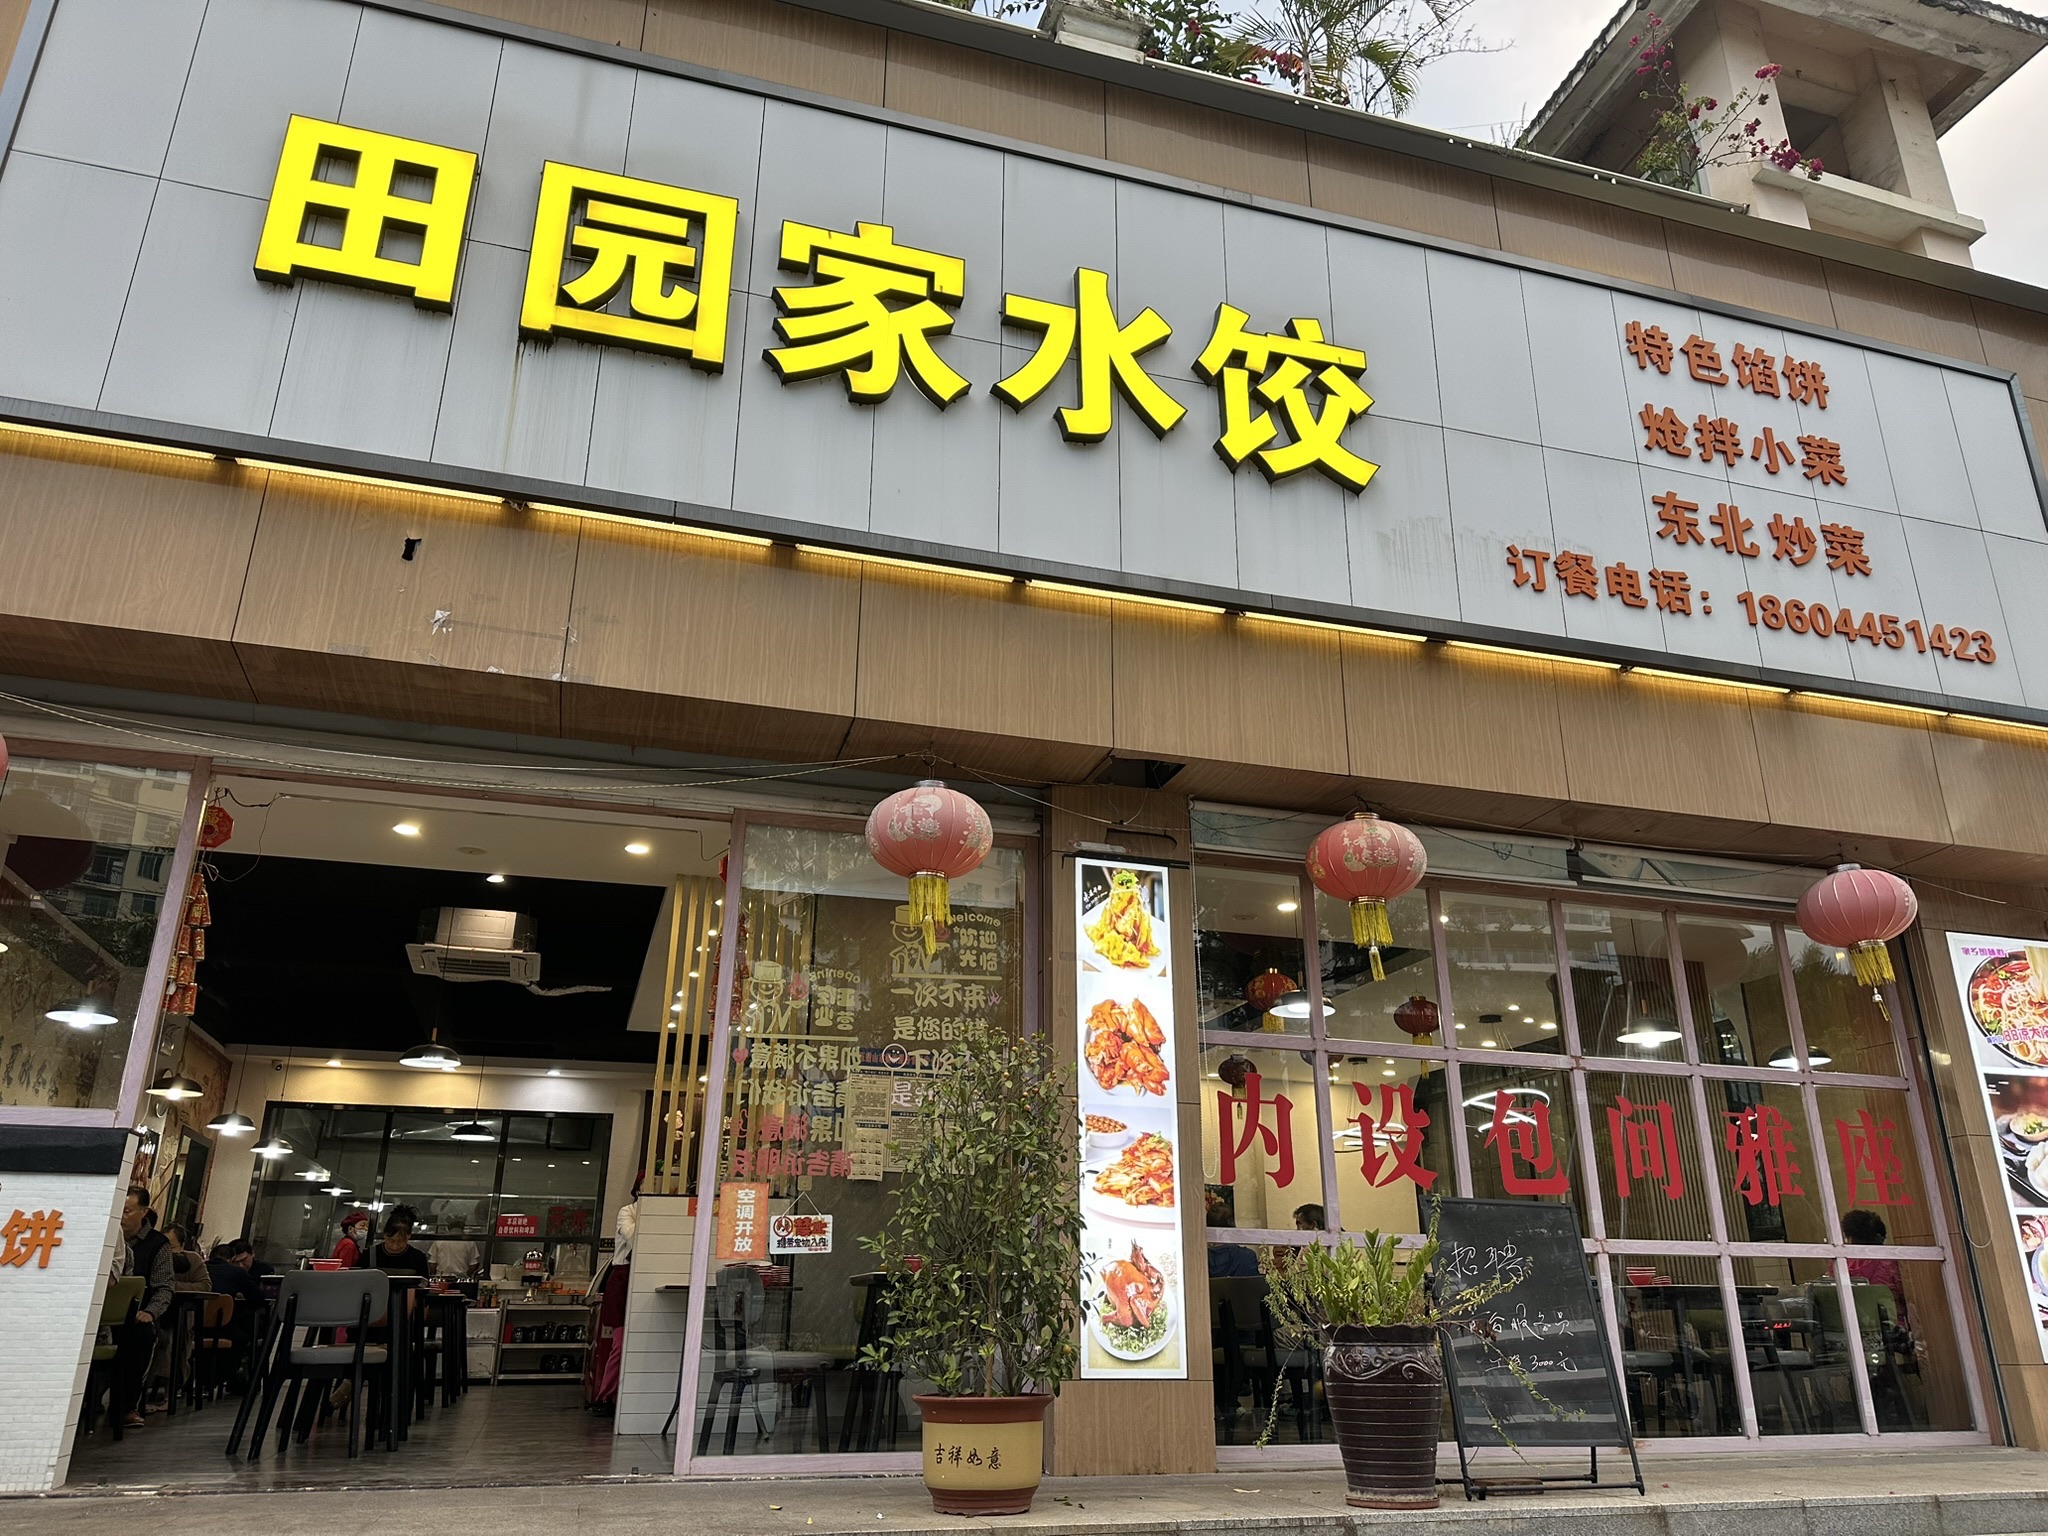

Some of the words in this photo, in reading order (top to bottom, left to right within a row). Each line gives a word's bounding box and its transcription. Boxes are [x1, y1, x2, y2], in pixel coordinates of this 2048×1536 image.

[253, 114, 1380, 494] 田园家水饺
[1625, 320, 1830, 409] 特色馅饼
[1638, 402, 1849, 486] 炝拌小菜
[1651, 490, 1873, 576] 东北炒菜
[1737, 590, 1998, 665] 18604451423
[959, 927, 998, 949] 欢迎
[959, 949, 998, 971] 光临
[890, 981, 987, 1009] 一次不来
[892, 1016, 989, 1041] 是您的错
[1217, 1072, 1916, 1208] 内设包间雅座
[0, 1208, 65, 1269] 饼
[733, 1188, 756, 1253] 空调开放
[794, 1216, 828, 1237] 禁止
[1446, 1239, 1524, 1284] 招聘
[934, 1442, 1002, 1470] 吉祥如意
